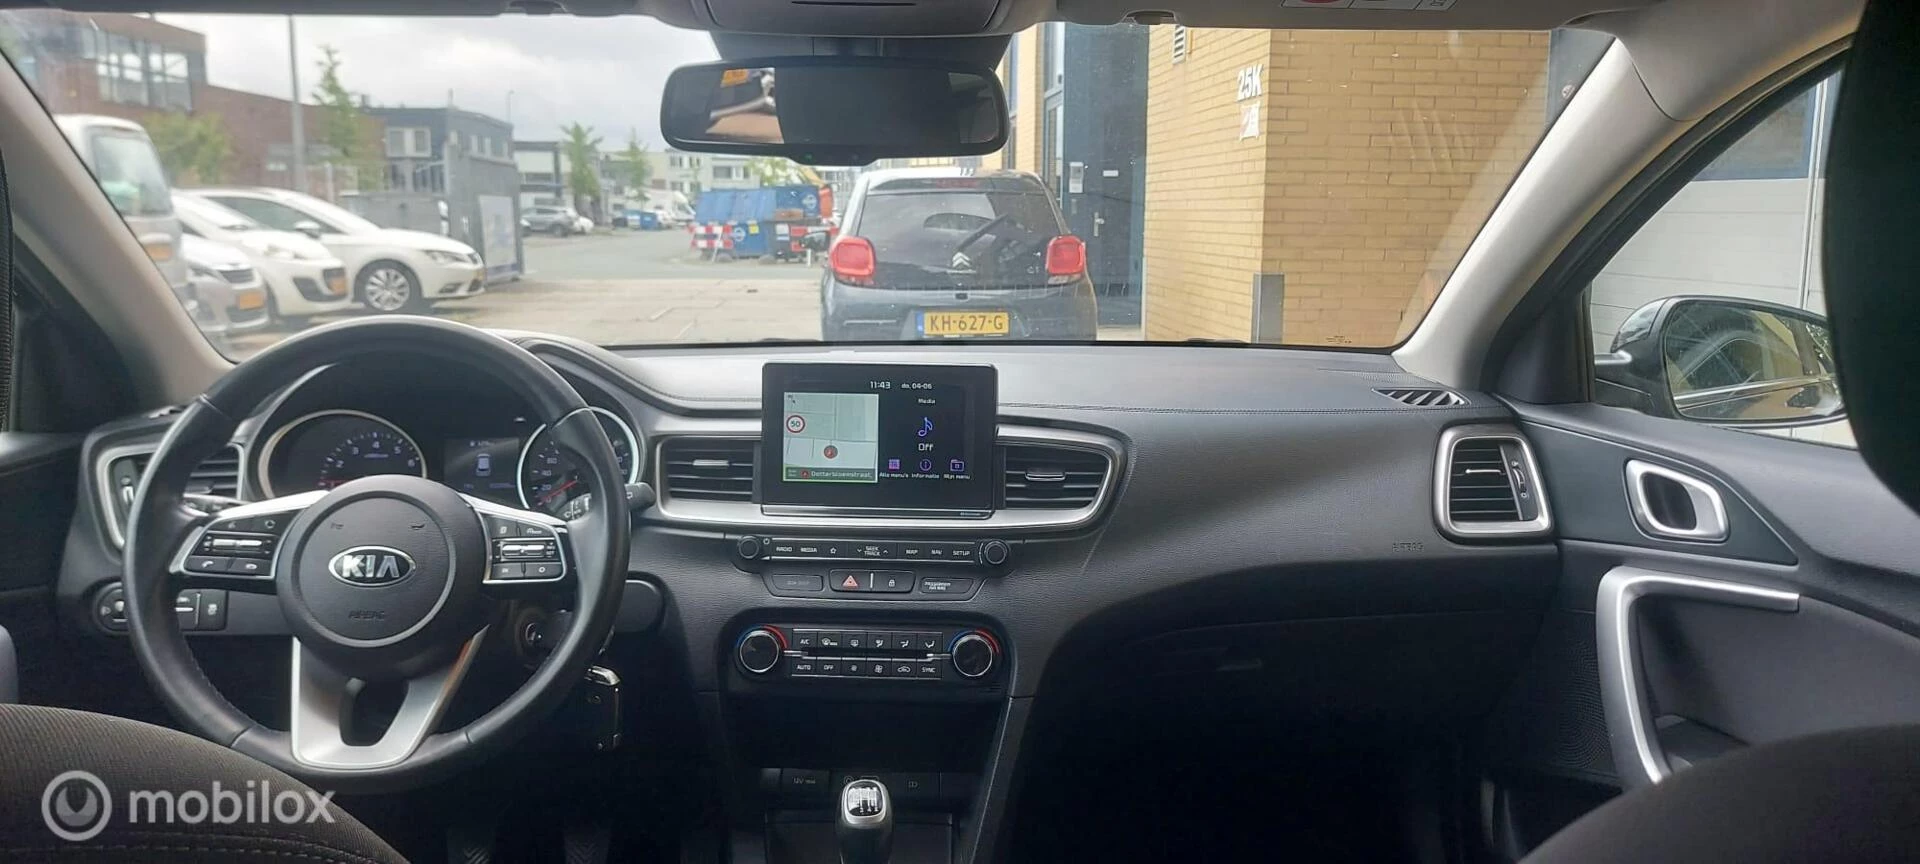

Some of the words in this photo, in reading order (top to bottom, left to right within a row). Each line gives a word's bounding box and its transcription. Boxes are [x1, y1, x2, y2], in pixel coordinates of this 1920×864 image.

[1237, 64, 1264, 101] 25K
[930, 315, 1004, 332] KH-627-G
[870, 381, 891, 389] 11:43
[790, 420, 801, 428] 50
[918, 443, 934, 451] Off
[342, 554, 400, 578] KIA
